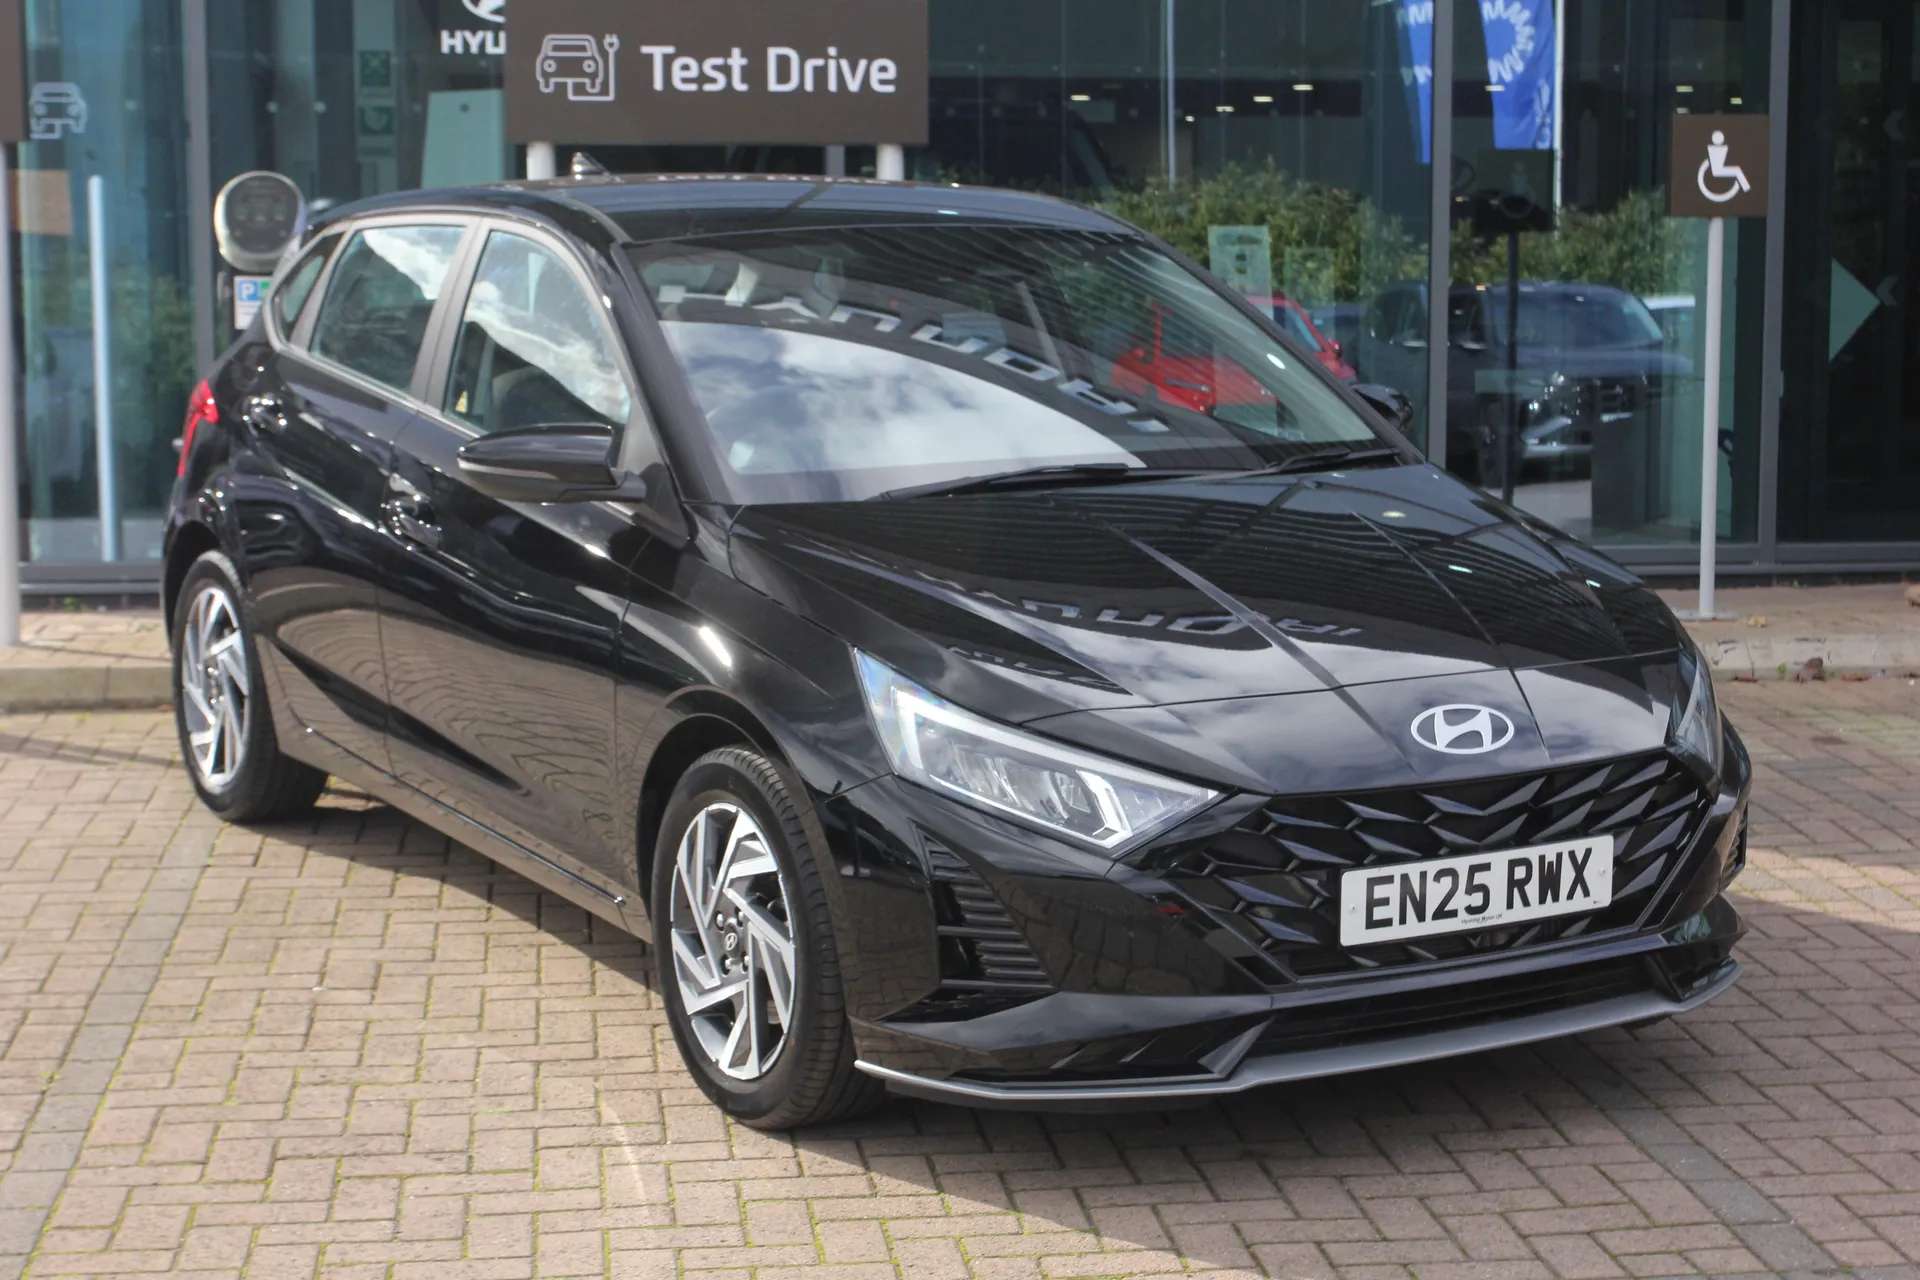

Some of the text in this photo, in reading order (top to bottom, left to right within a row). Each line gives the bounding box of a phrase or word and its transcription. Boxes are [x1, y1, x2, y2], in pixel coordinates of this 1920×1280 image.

[440, 29, 507, 55] HYU
[640, 45, 898, 93] Test Drive
[1364, 847, 1593, 931] EN25 RWX
